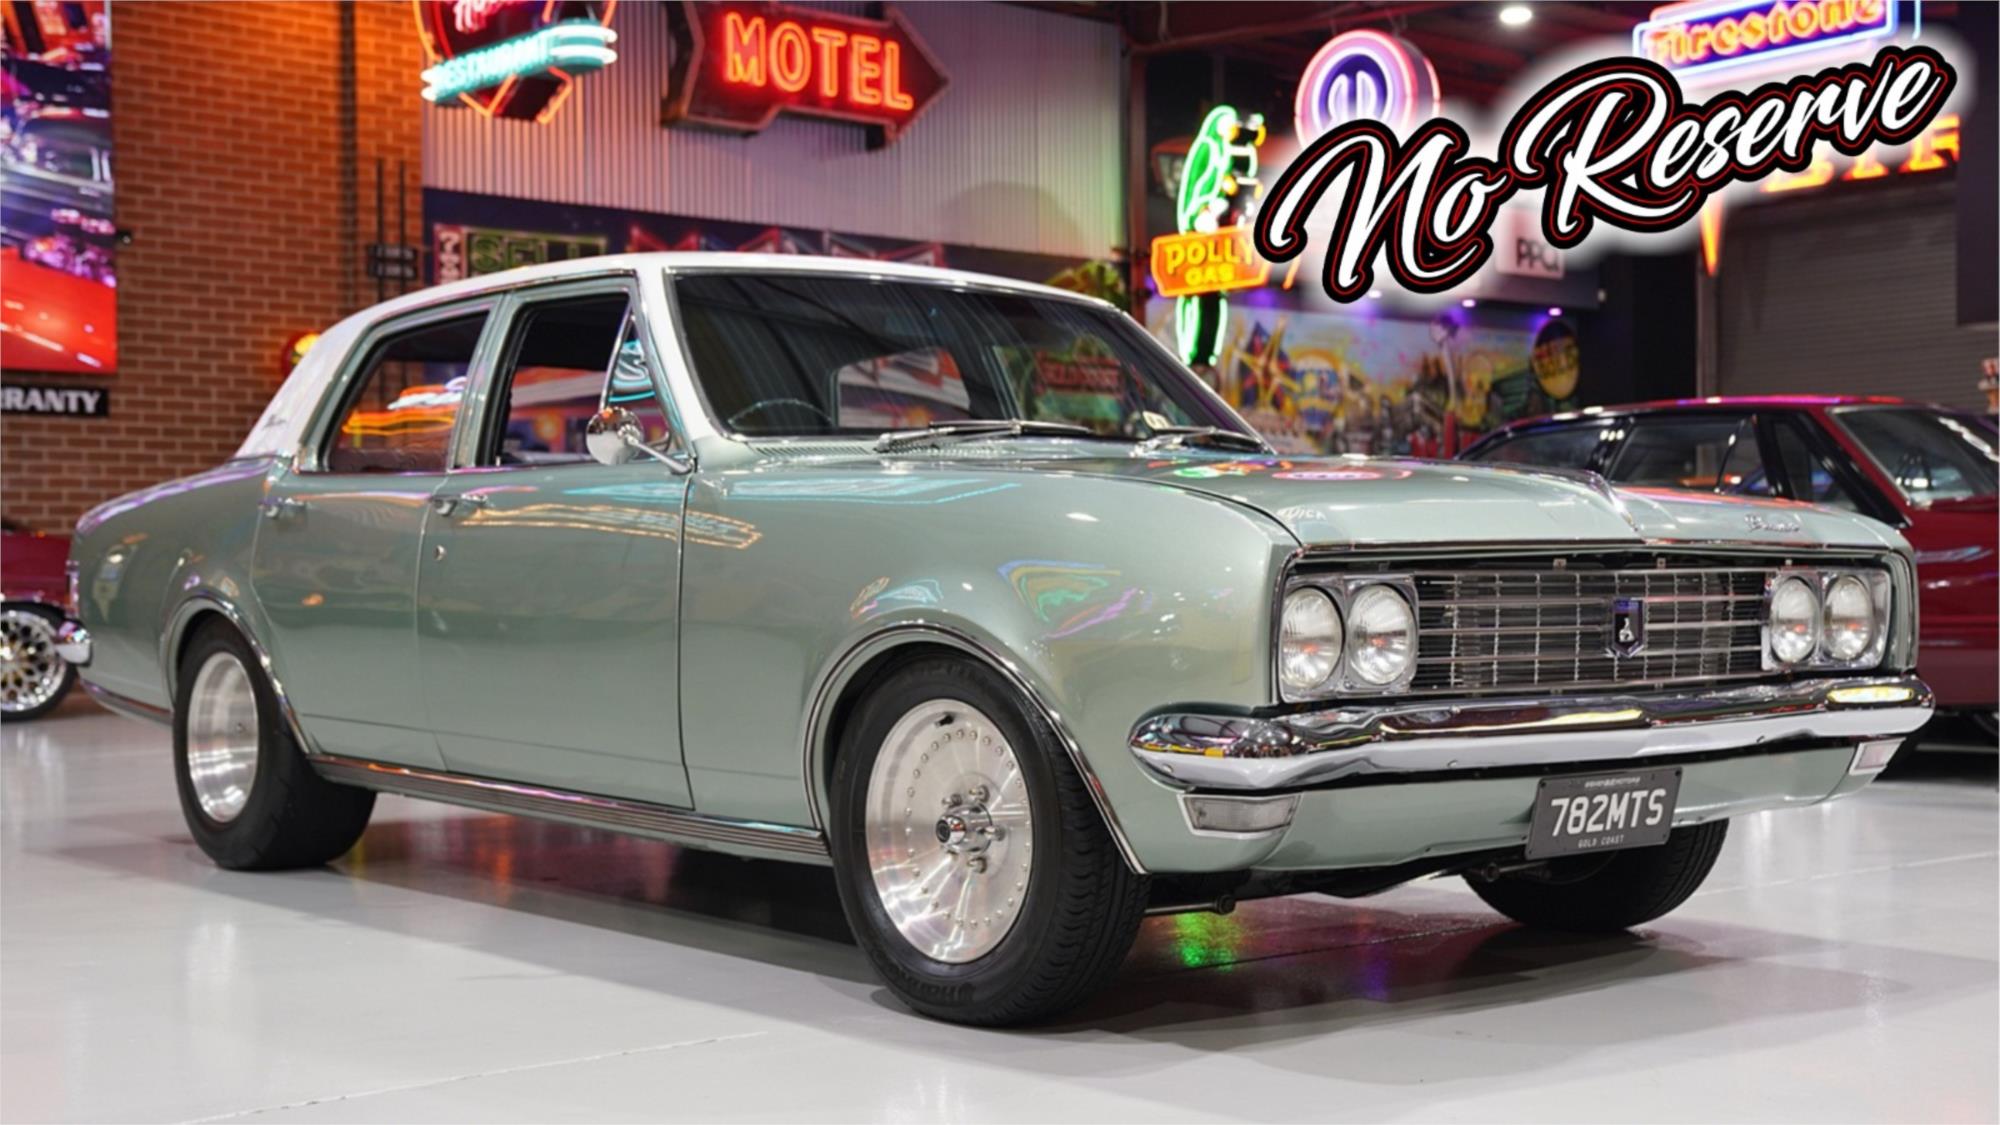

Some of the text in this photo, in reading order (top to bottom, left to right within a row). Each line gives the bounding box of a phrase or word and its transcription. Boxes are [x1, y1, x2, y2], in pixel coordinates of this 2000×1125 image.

[1649, 0, 1884, 64] Firestone
[724, 11, 915, 111] MOTEL
[1165, 237, 1254, 275] POLLY
[1184, 263, 1235, 287] GAS
[1, 386, 101, 414] RANTY
[1551, 788, 1668, 838] 782MTS
[1578, 834, 1625, 849] GOLD COAST
